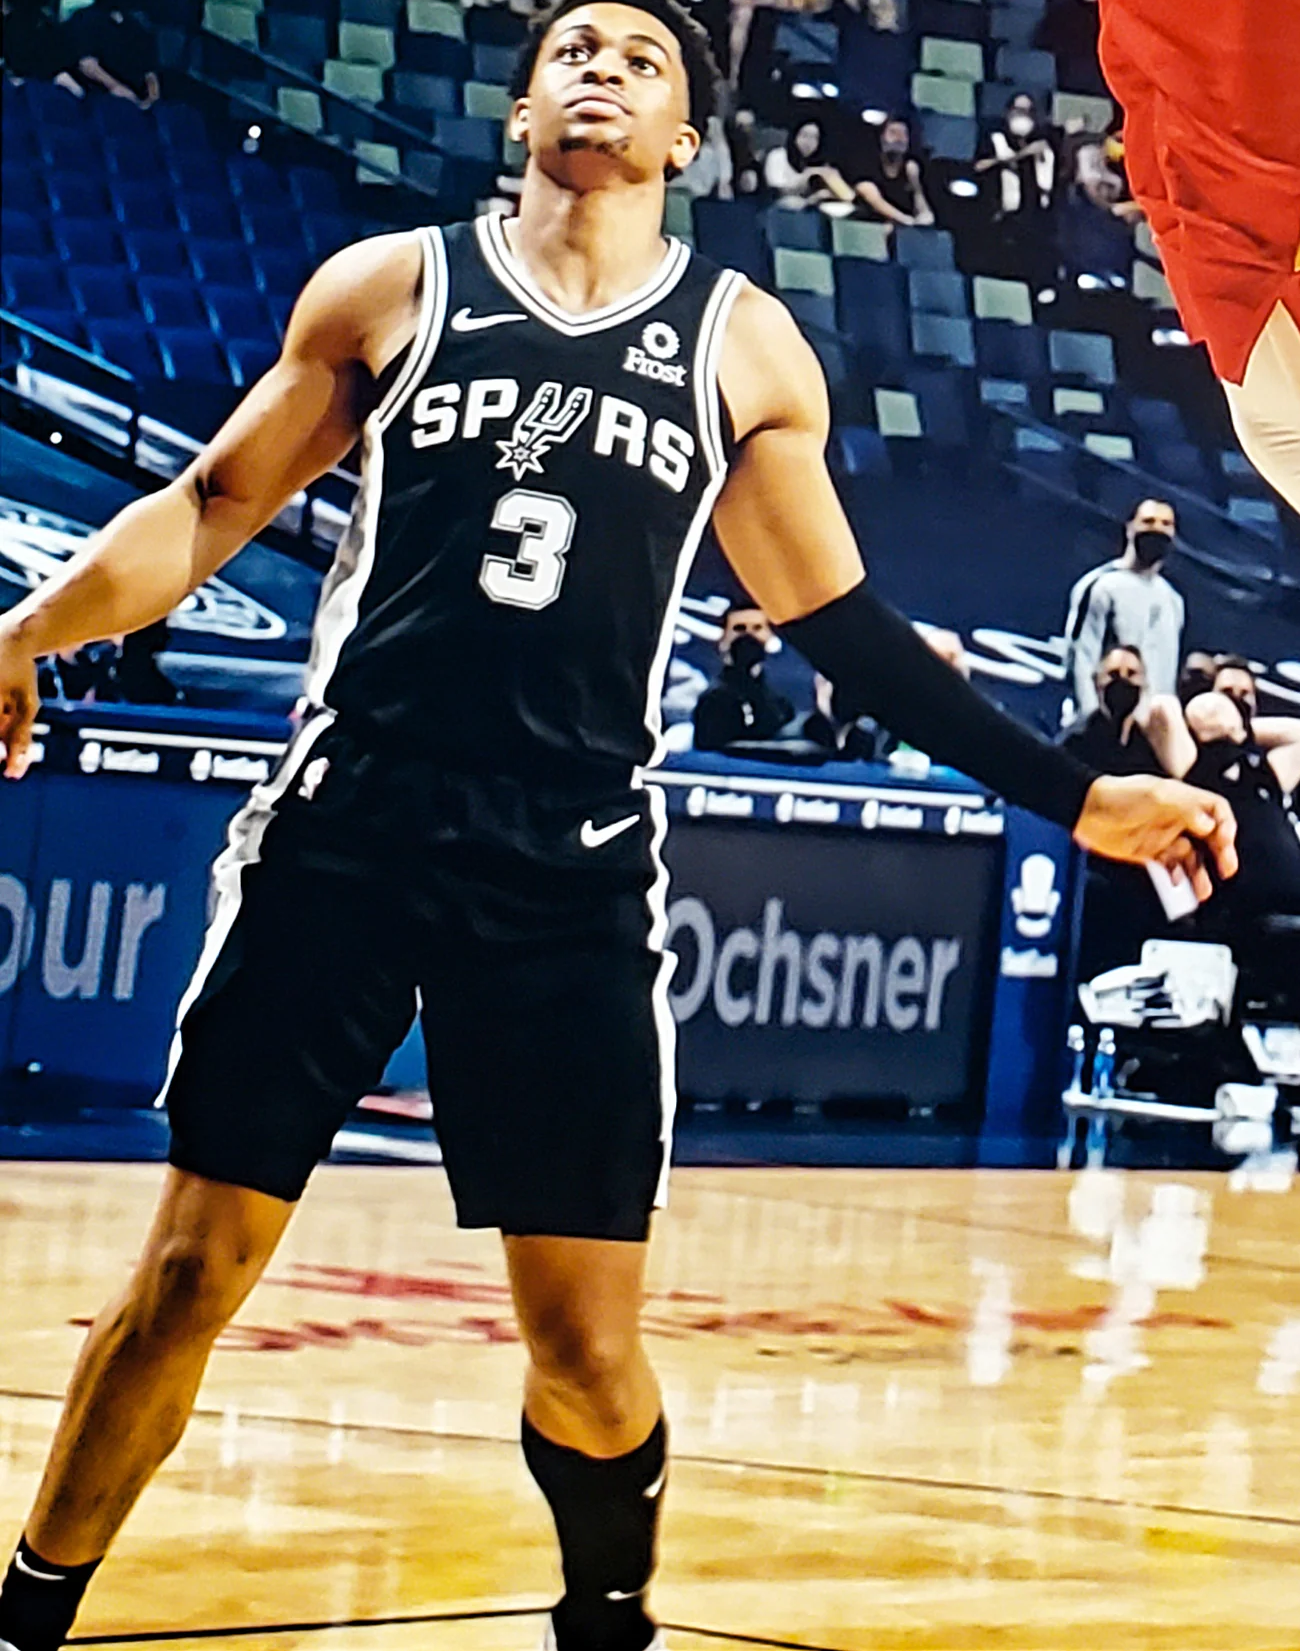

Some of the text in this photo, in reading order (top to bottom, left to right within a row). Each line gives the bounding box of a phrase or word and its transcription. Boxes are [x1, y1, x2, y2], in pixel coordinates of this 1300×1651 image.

[623, 346, 688, 387] Frost
[410, 377, 696, 494] SPURS
[478, 487, 578, 611] 3
[667, 896, 961, 1032] Ochsner
